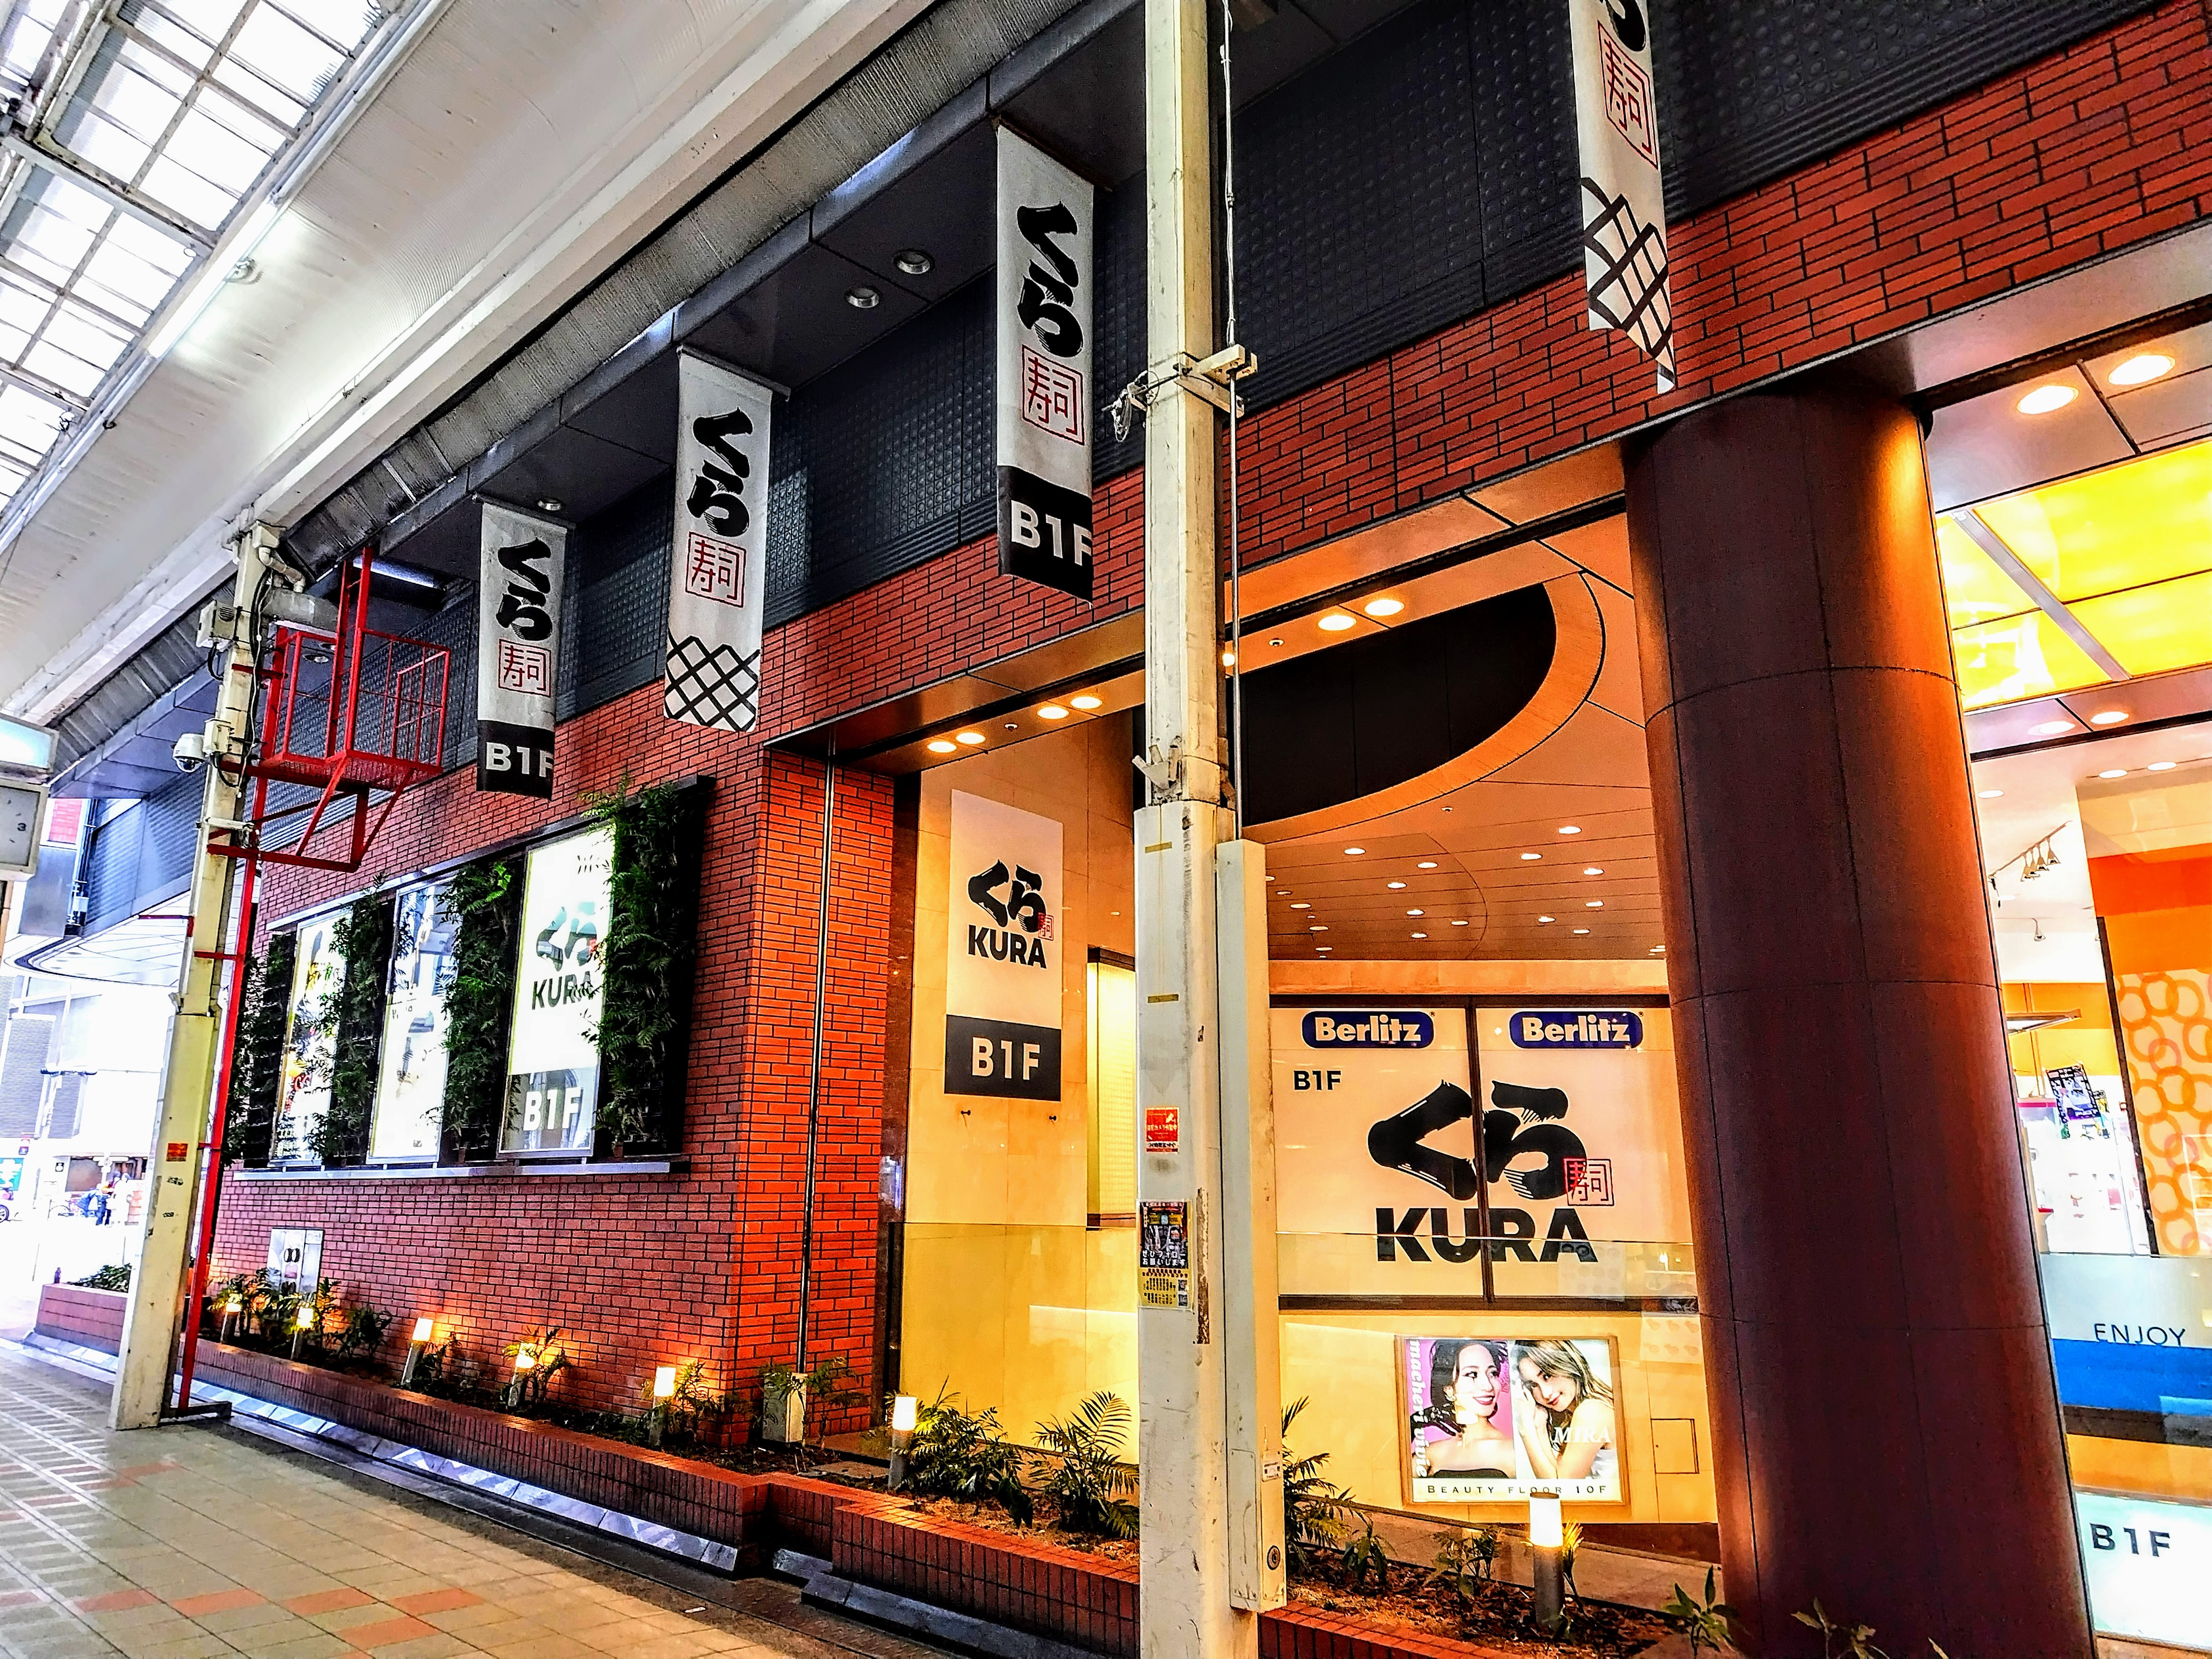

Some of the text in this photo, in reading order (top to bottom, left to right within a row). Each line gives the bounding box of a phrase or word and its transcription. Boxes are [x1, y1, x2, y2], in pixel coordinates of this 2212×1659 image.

[1604, 39, 1653, 155] 寿司
[1017, 200, 1083, 357] くら
[1027, 356, 1079, 435] 寿司
[686, 407, 753, 537] くら
[1011, 500, 1092, 566] B1F
[496, 537, 553, 641] くら
[691, 539, 739, 600] 寿司
[503, 645, 547, 692] 寿司
[486, 742, 554, 777] B1F
[968, 859, 1046, 932] くら
[968, 924, 1047, 969] KURA
[532, 971, 594, 1010] KURA
[1315, 1014, 1421, 1041] Berlitz
[1522, 1014, 1630, 1041] Berlitz
[971, 1035, 1041, 1081] B1F
[1294, 1071, 1341, 1090] B1F
[523, 1087, 581, 1131] B1F
[1367, 1079, 1587, 1201] くら
[1568, 1160, 1611, 1203] 寿司
[1375, 1208, 1598, 1262] KURA
[2094, 1323, 2186, 1347] ENJOY
[1553, 1426, 1612, 1443] MIRA
[2090, 1523, 2171, 1557] B1F
